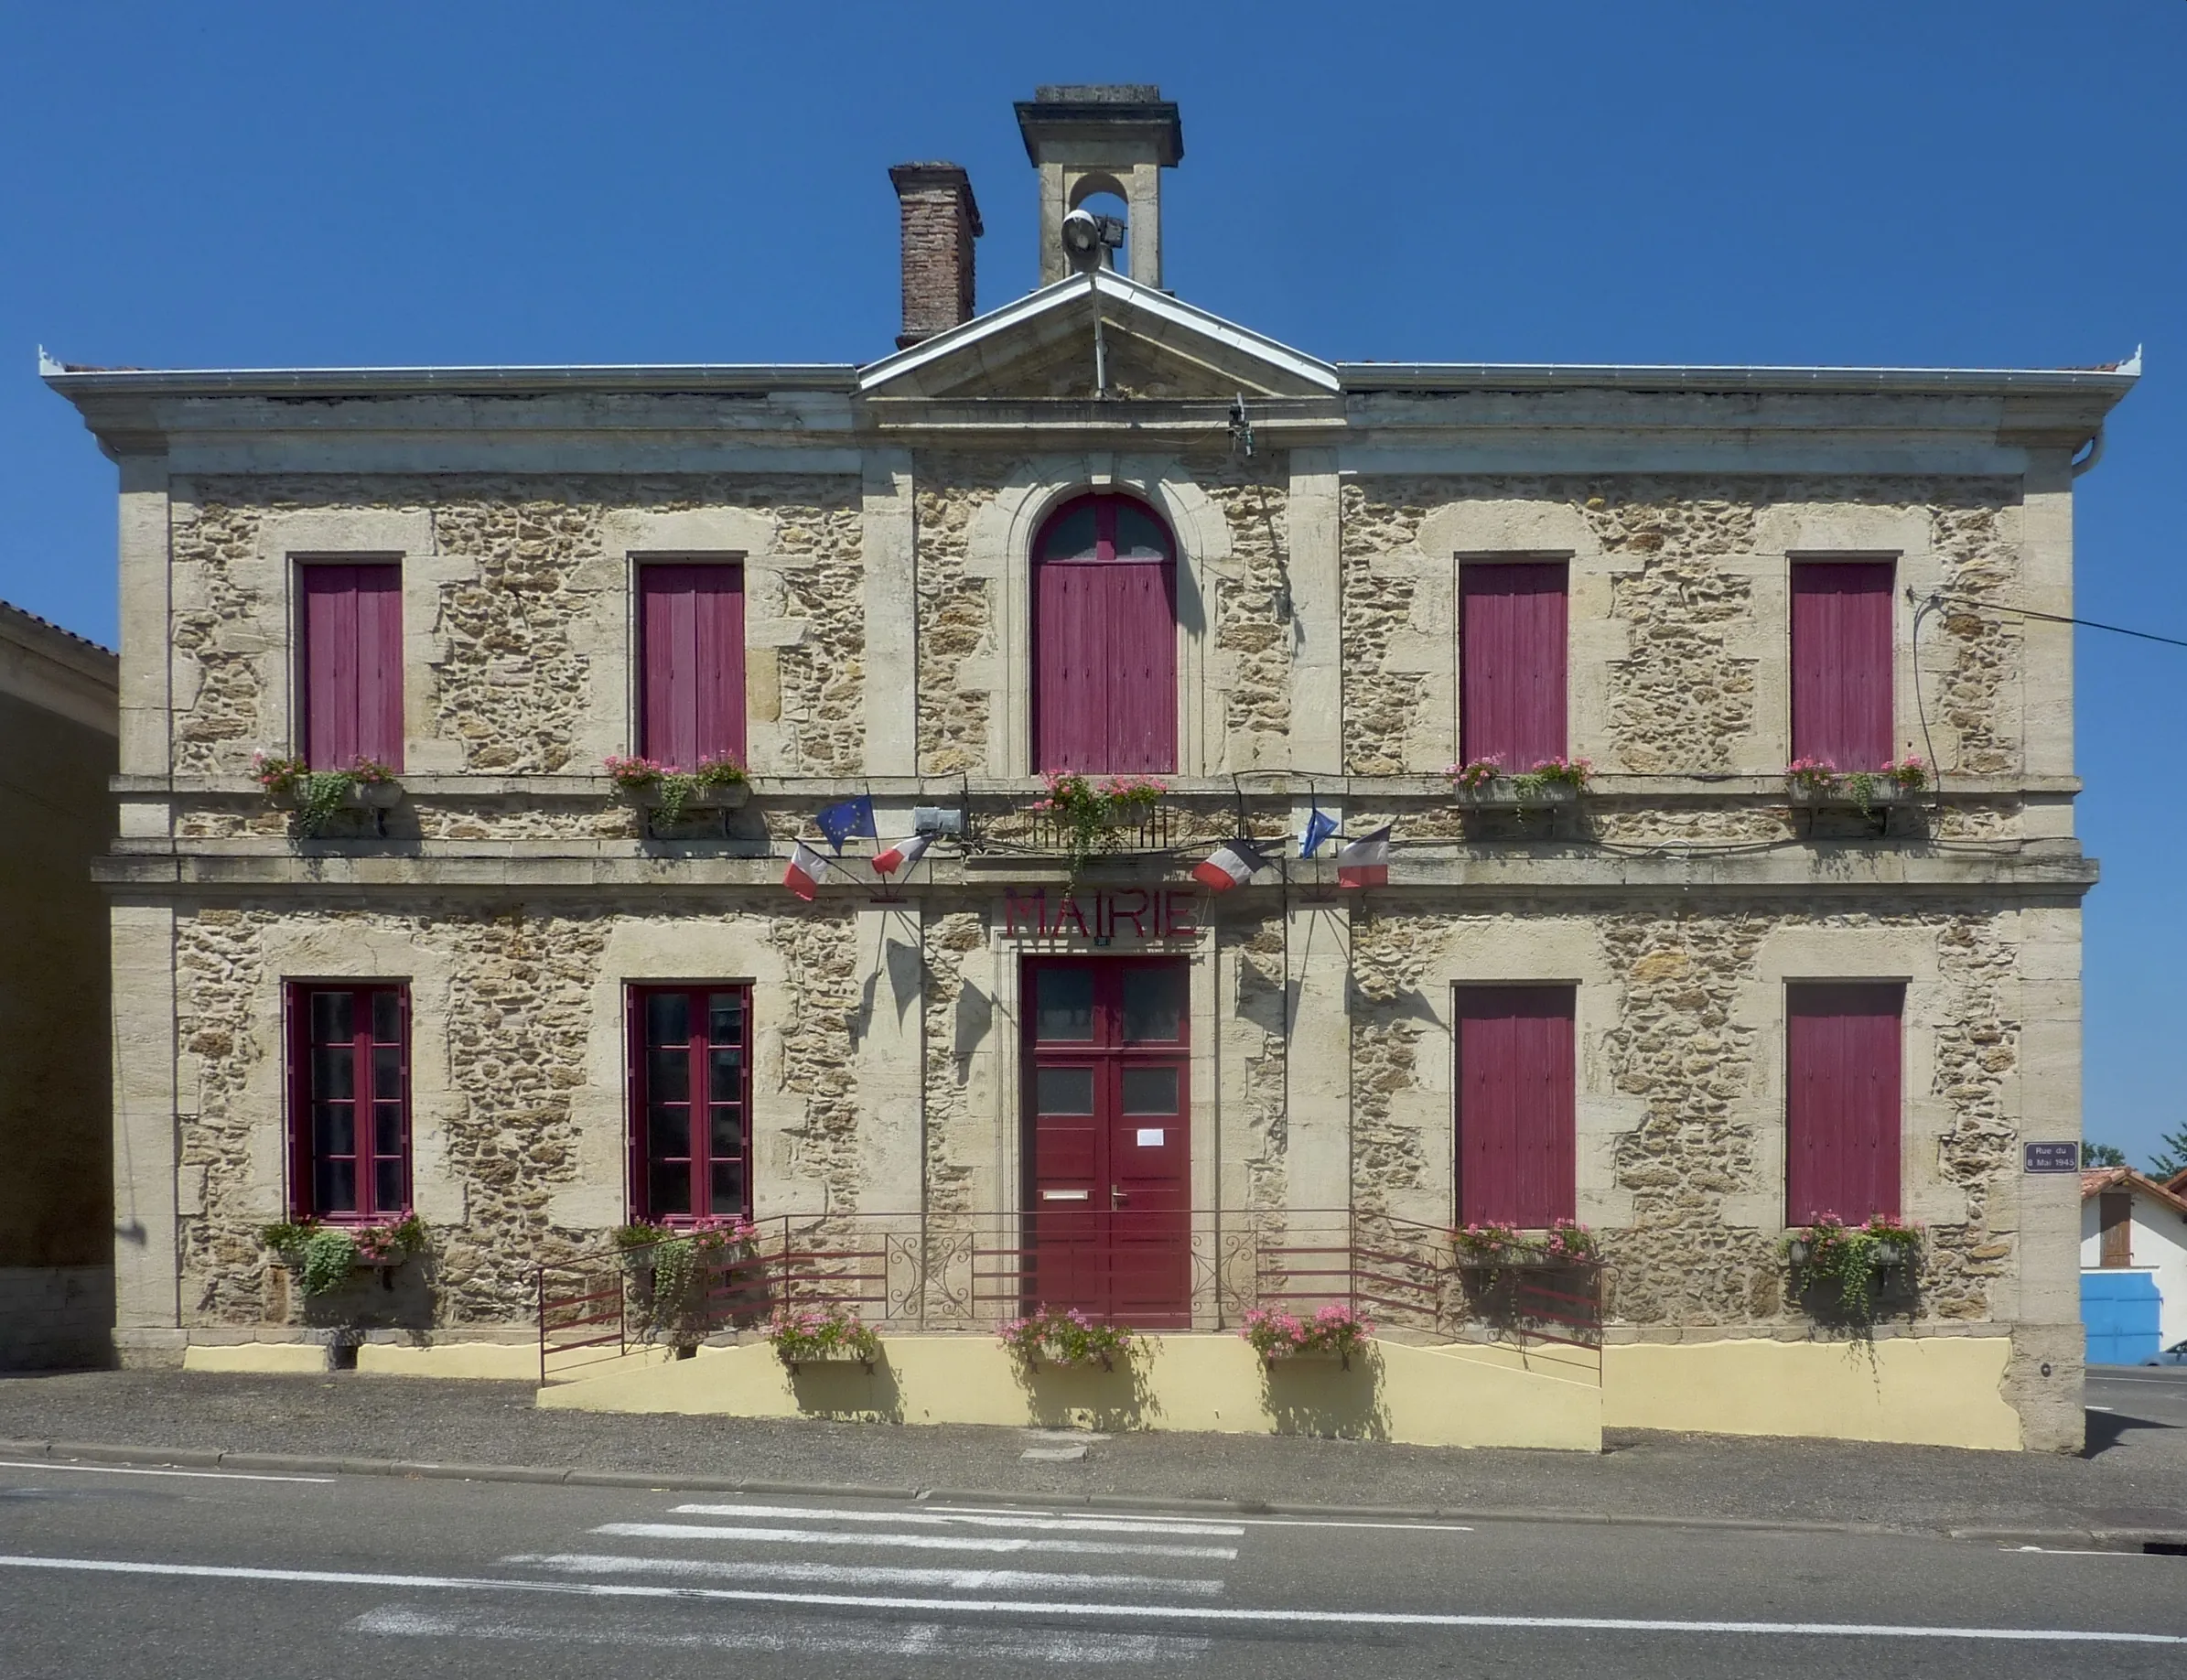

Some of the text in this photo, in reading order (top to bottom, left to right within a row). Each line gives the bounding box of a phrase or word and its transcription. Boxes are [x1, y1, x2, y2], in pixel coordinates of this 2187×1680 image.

[1004, 886, 1198, 938] MAIRIE
[2035, 1147, 2066, 1155] Rue du
[2027, 1158, 2074, 1167] 8 Mai 1945
